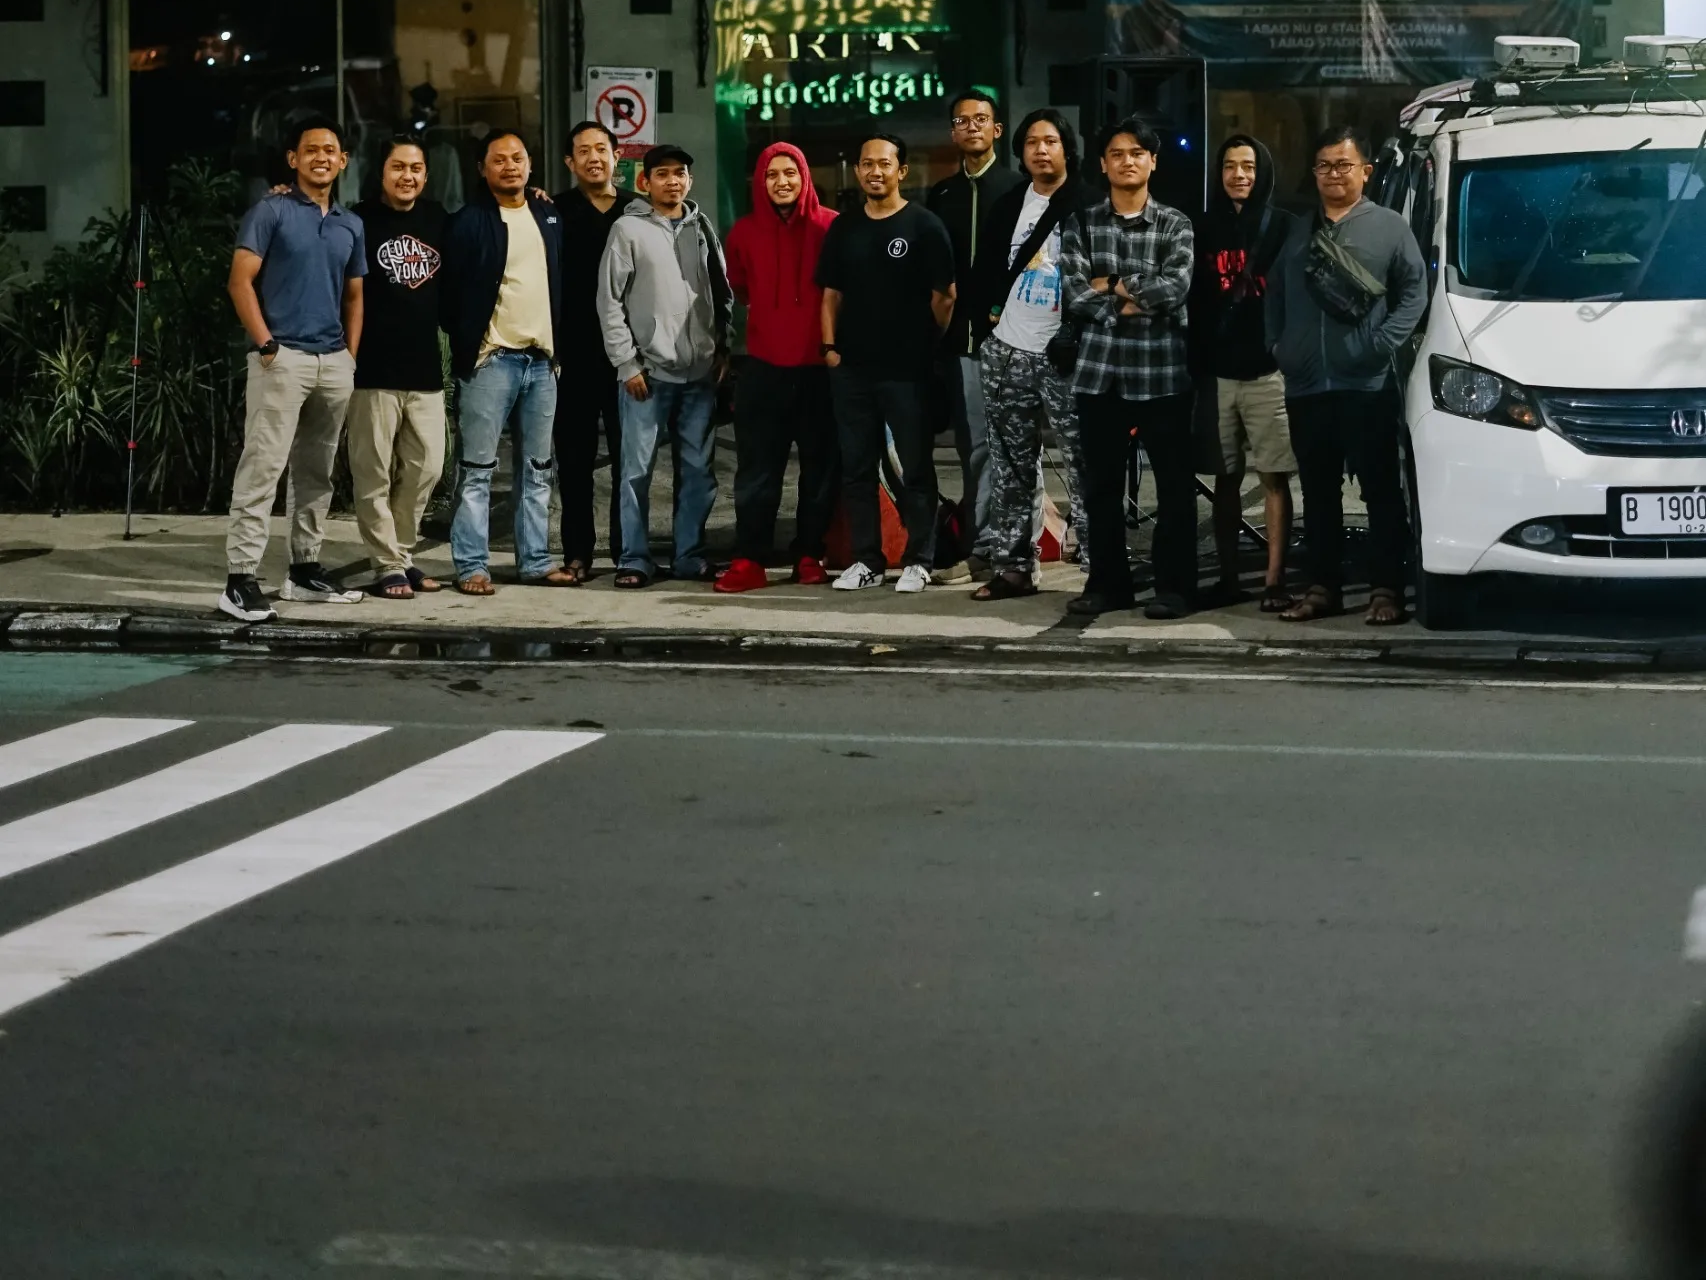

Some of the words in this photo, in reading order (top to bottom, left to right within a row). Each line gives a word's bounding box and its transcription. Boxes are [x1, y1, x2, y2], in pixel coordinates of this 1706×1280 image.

[386, 239, 427, 258] LOKAL
[1625, 497, 1639, 522] B
[1657, 494, 1706, 521] 1900
